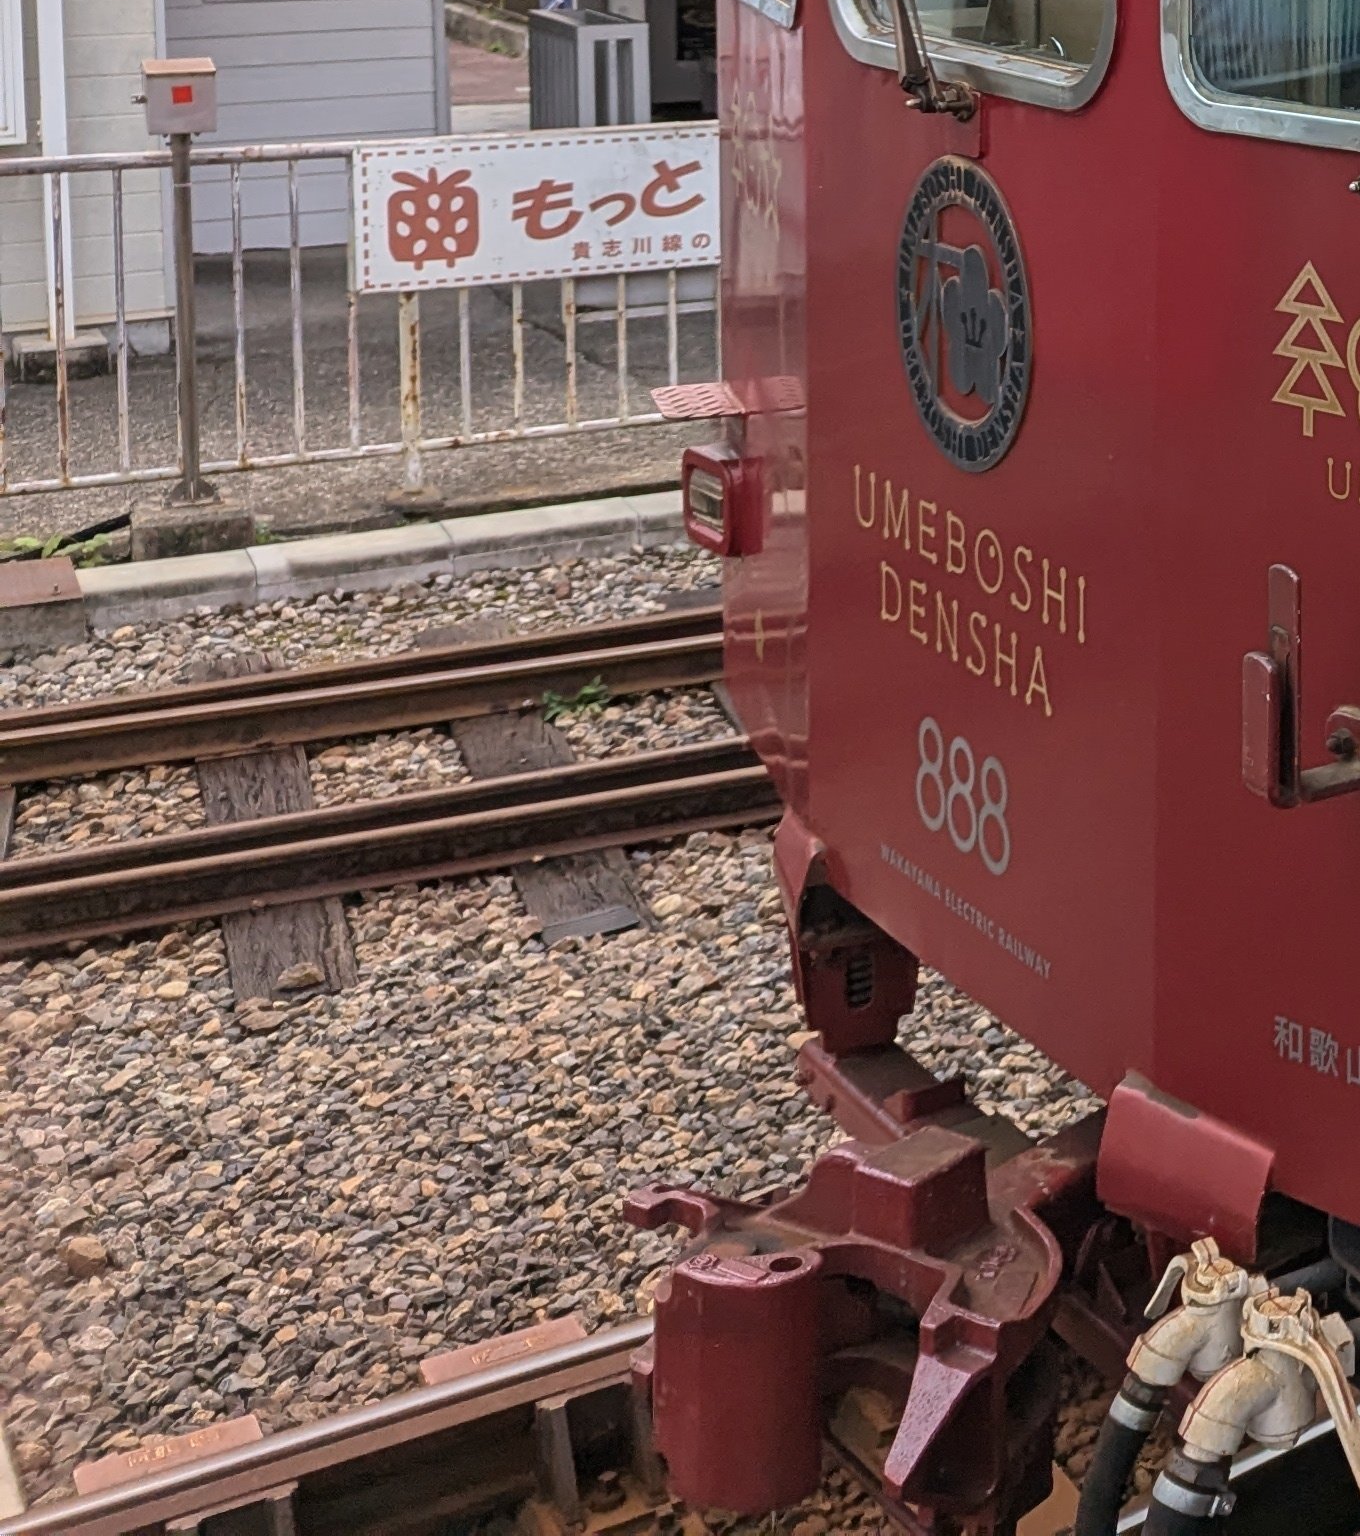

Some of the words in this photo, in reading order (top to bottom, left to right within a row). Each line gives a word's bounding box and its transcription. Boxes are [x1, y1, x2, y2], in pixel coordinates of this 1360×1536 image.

[511, 159, 707, 241] もっと
[572, 233, 711, 261] 貴志川線の
[853, 464, 1086, 644] UMEBOSHI
[880, 560, 1053, 718] DENSHA
[915, 716, 1011, 876] 888
[879, 842, 942, 901] WAKAYAMA
[944, 888, 995, 940] ELECTRIC
[998, 927, 1052, 980] RAILWAY
